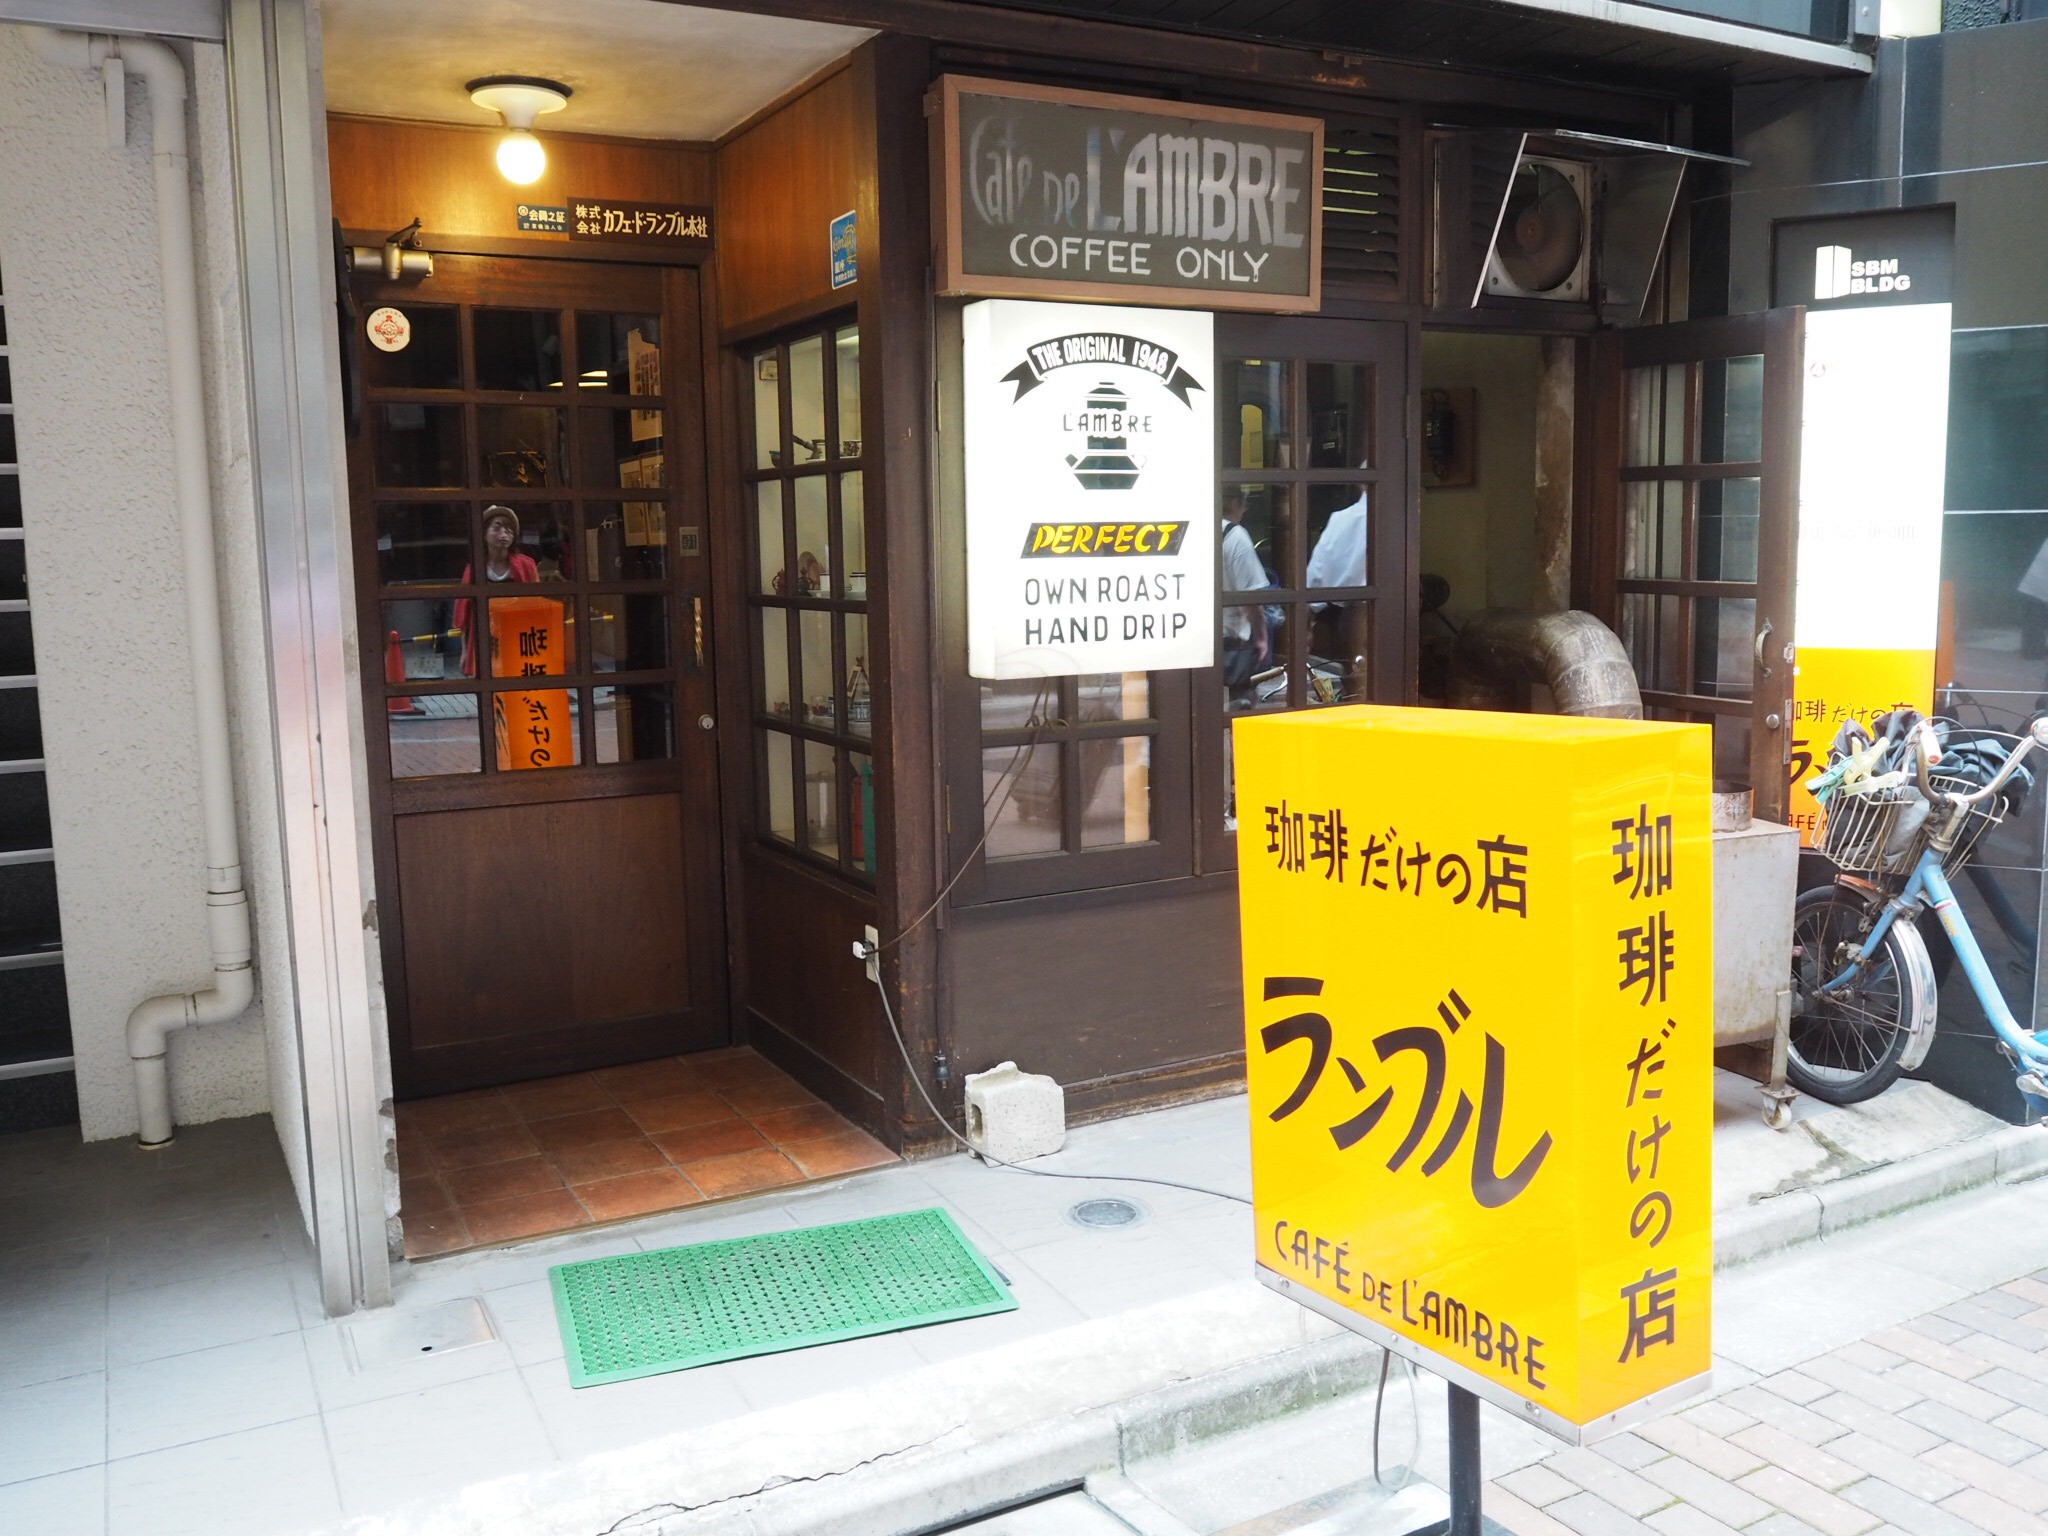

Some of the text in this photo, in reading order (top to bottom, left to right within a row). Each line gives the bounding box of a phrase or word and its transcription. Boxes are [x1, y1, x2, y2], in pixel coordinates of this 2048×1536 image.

[1086, 127, 1305, 248] L'AMBRE
[575, 203, 601, 219] 株式
[576, 222, 601, 235] 会社
[1009, 233, 1269, 283] COFFEE ONLY
[1851, 258, 1899, 277] SBM
[1851, 275, 1911, 294] BLDG
[1031, 335, 1169, 375] THE ORIGINAL 1948
[1031, 524, 1179, 554] PERFECT
[1024, 572, 1186, 606] OWN ROAST
[1024, 612, 1187, 646] HAND DRIP
[1265, 799, 1529, 919] 珈琲だけの店
[1259, 976, 1553, 1208] ランブル
[1611, 803, 1678, 1363] 珈琲だけの店
[1274, 1220, 1547, 1391] CAFÉ DE L'AMBRE
